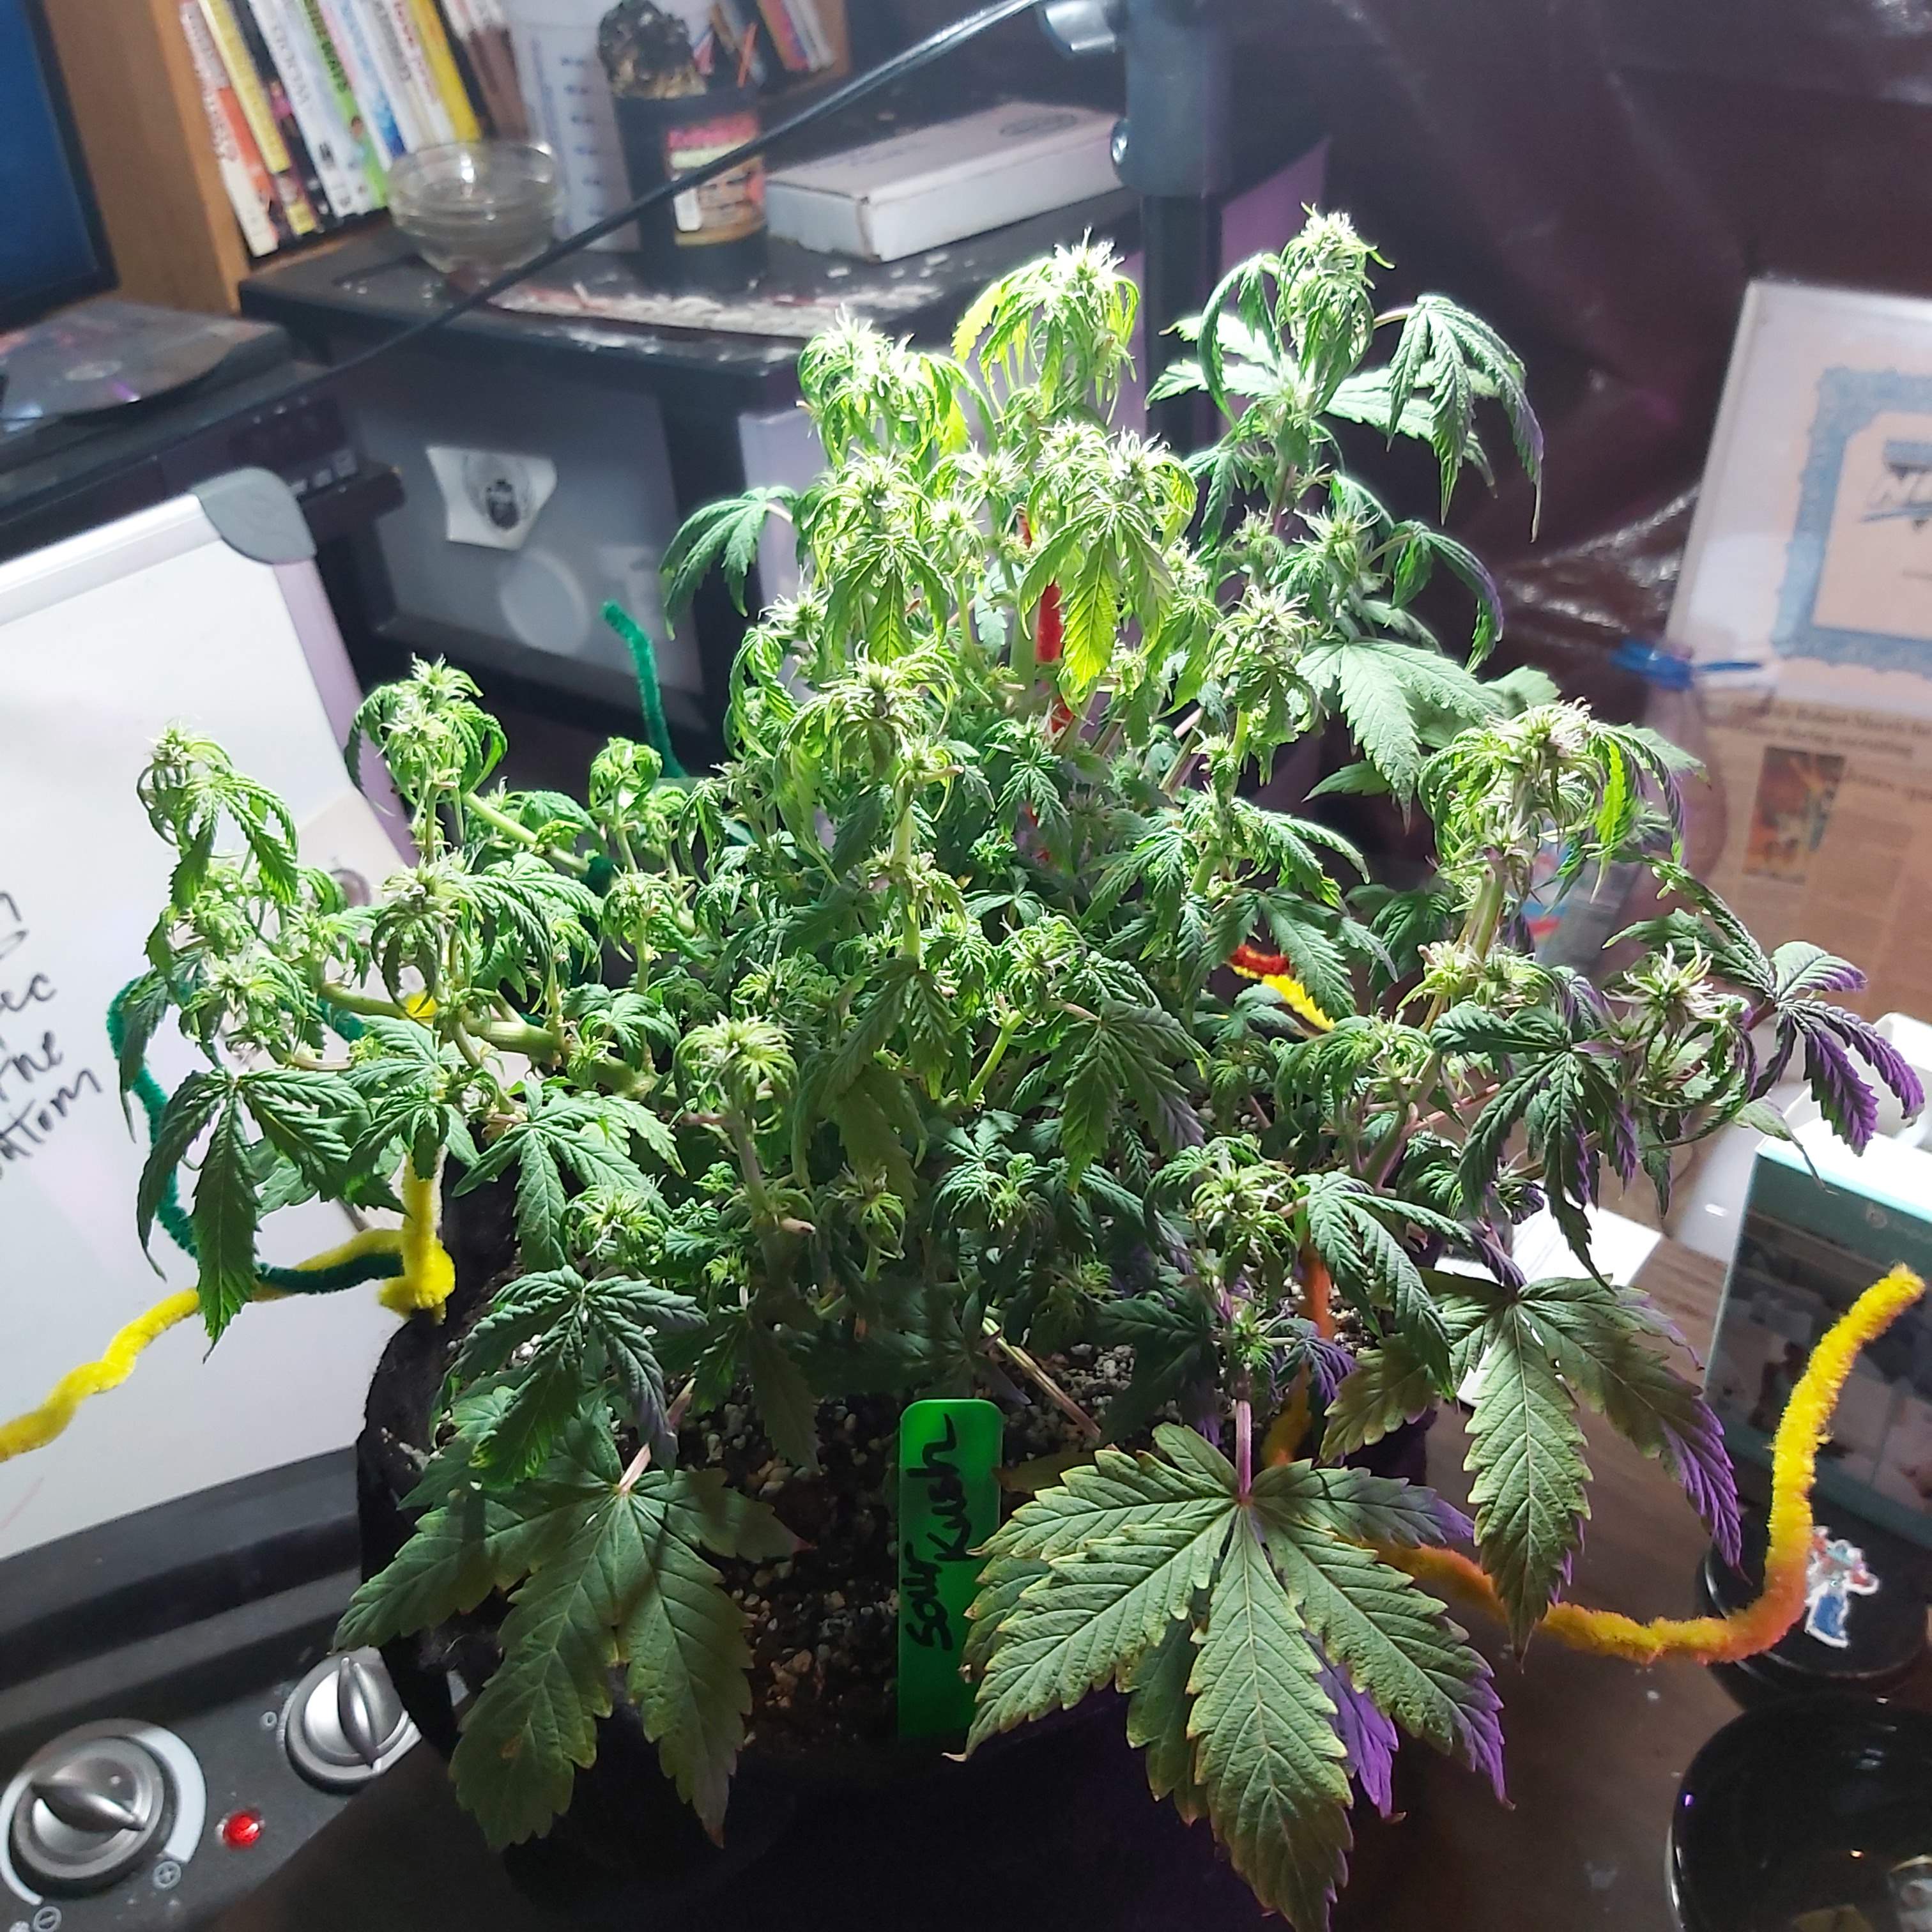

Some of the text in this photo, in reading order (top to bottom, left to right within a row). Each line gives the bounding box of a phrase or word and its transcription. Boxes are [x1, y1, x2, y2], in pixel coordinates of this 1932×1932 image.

[0, 1068, 102, 1179] ottom
[905, 1413, 976, 1561] Kush
[901, 1541, 953, 1651] Sour
